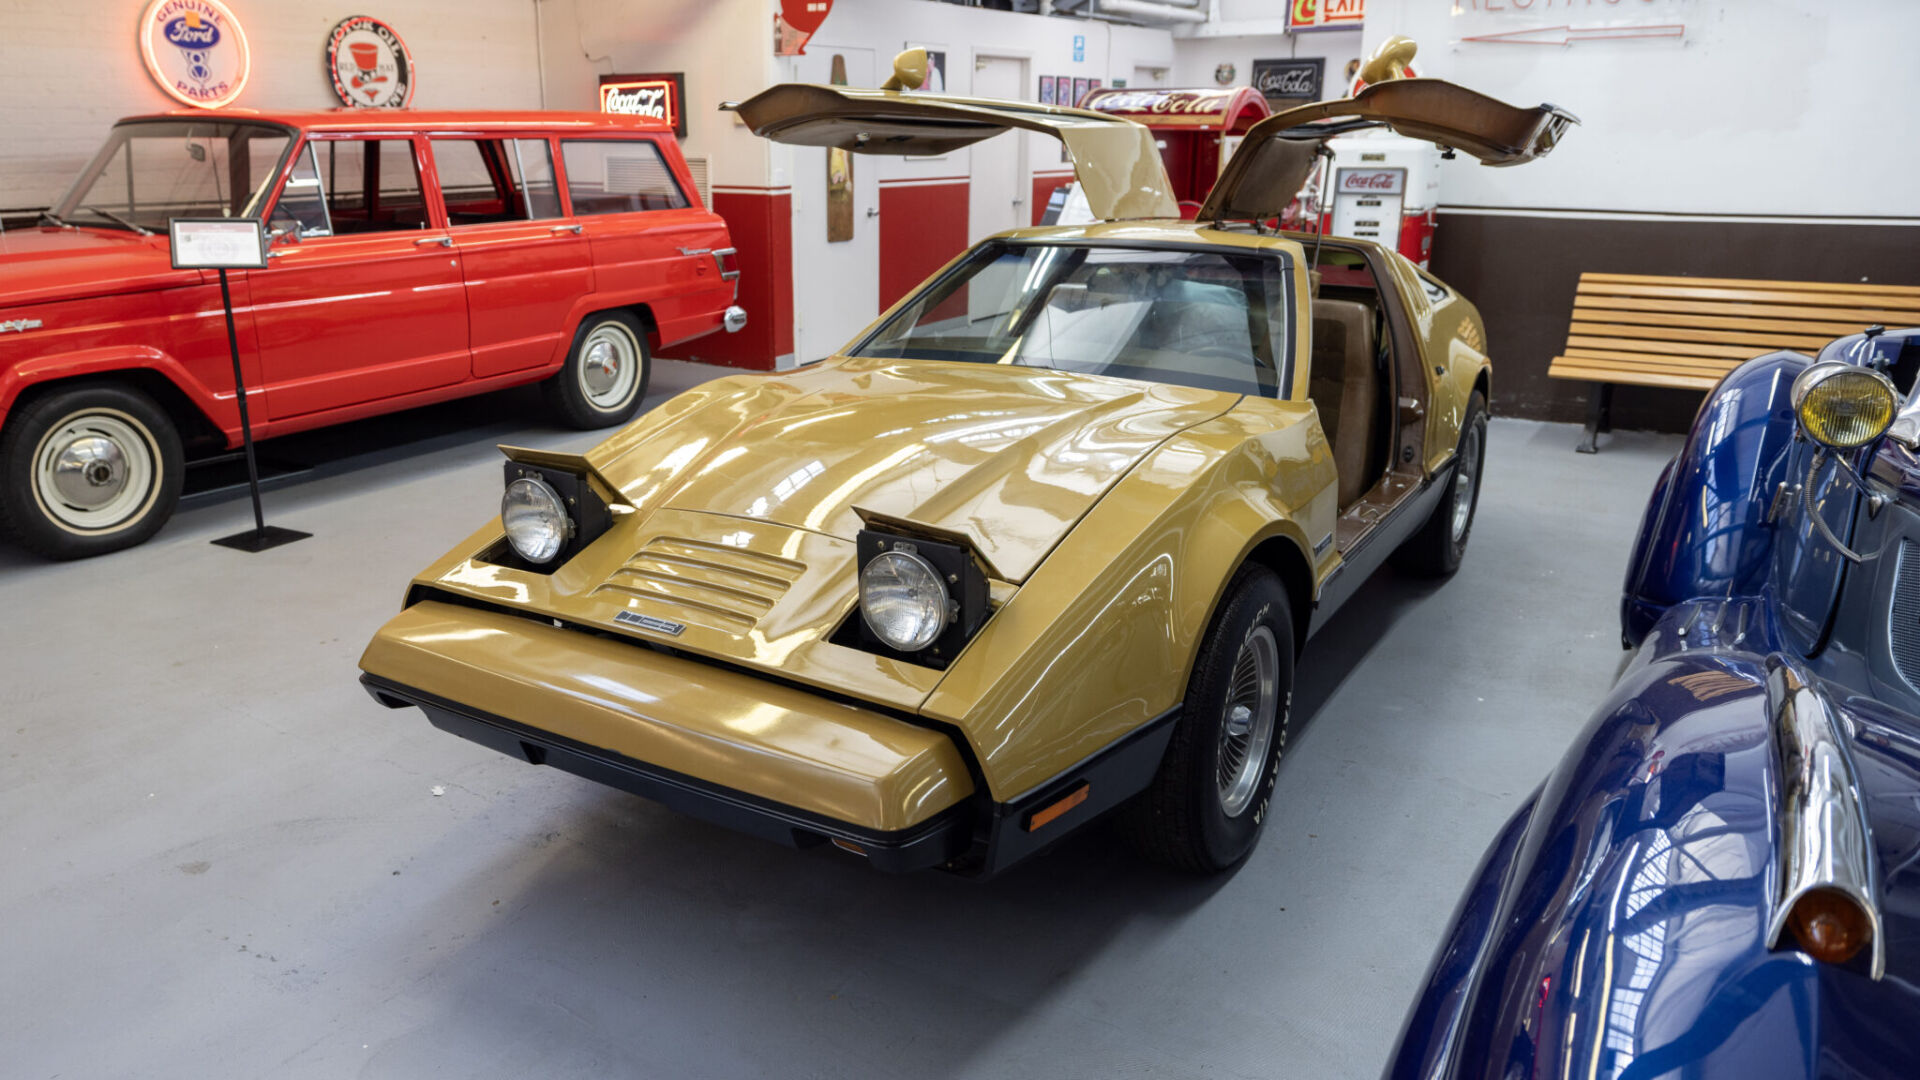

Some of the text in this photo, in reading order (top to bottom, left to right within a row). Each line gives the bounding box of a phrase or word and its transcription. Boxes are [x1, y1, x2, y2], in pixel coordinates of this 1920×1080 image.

[157, 0, 222, 24] GENUINE
[169, 19, 214, 43] Ford
[378, 26, 400, 58] OIL
[177, 80, 228, 98] PARTS
[1267, 691, 1292, 789] RADIAL
